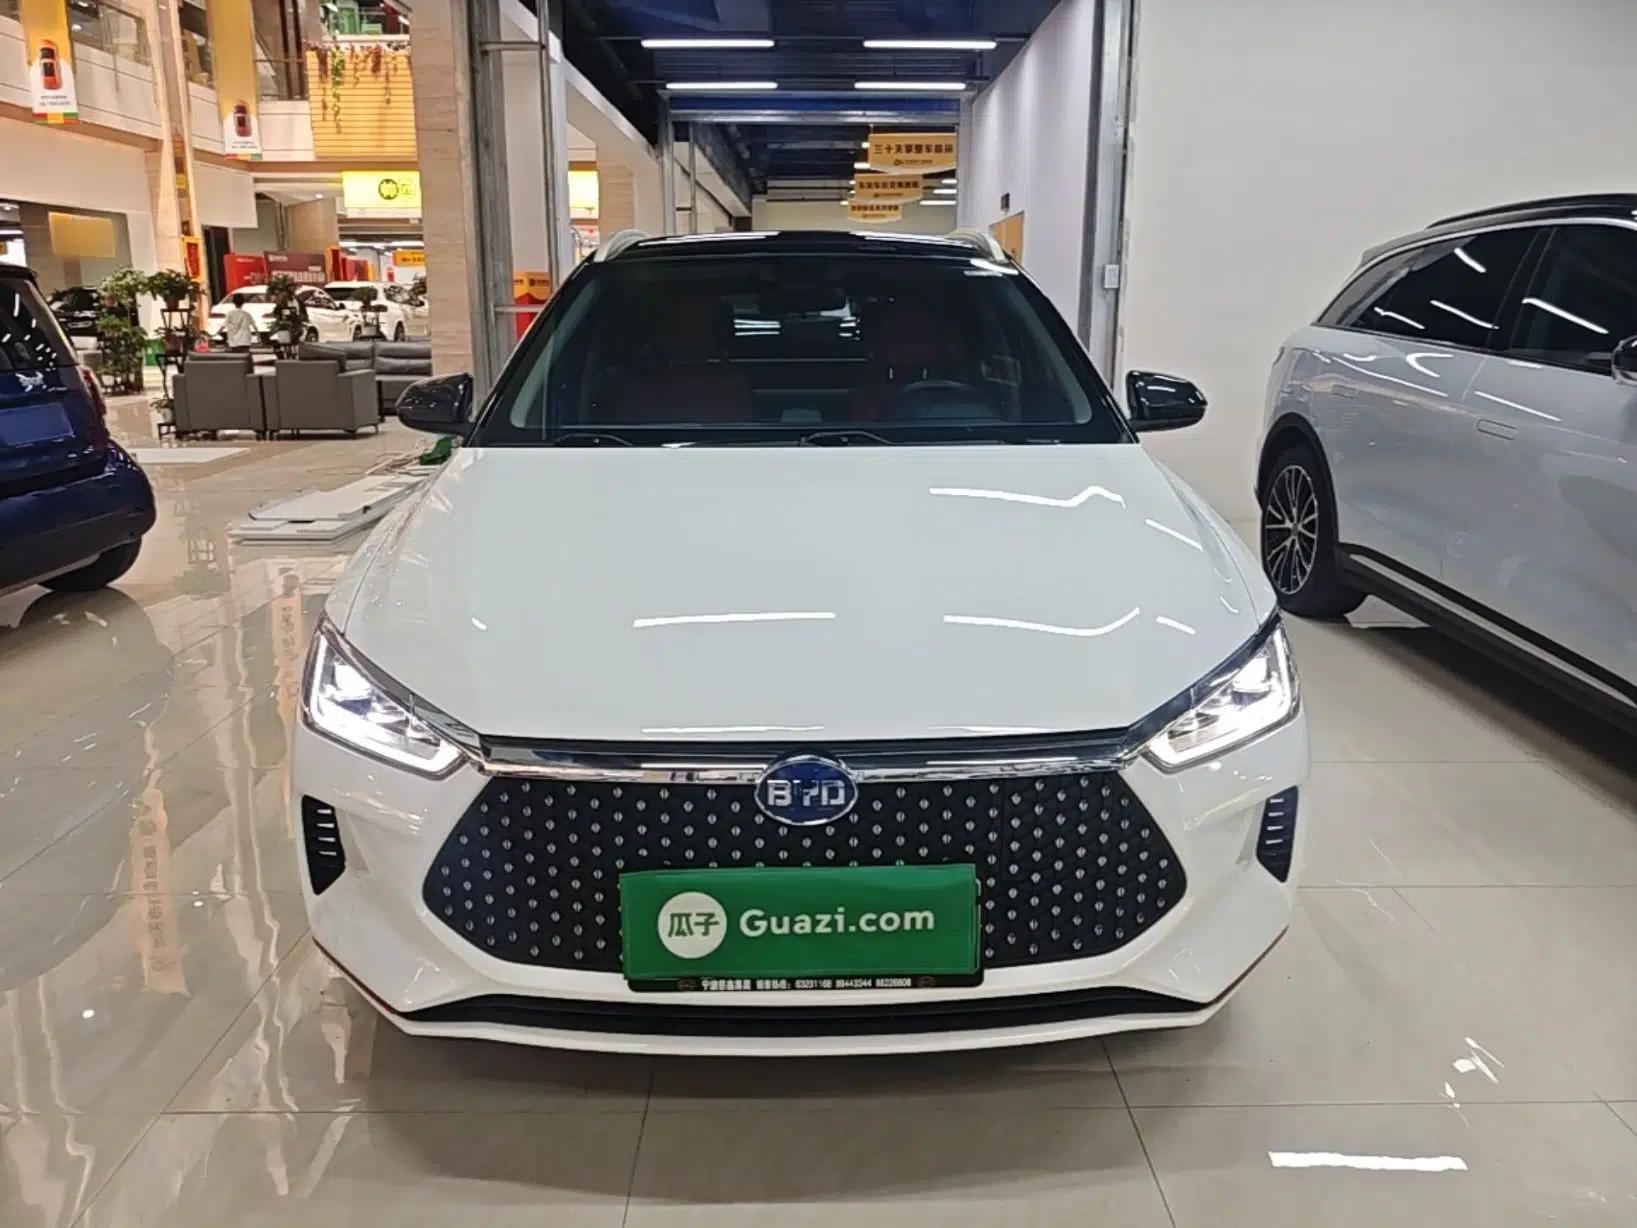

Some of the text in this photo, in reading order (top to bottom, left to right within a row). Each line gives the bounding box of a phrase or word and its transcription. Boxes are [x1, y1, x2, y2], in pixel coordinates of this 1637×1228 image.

[766, 779, 846, 807] BYD
[668, 912, 720, 938] 瓜子
[739, 907, 935, 938] Guazi.com
